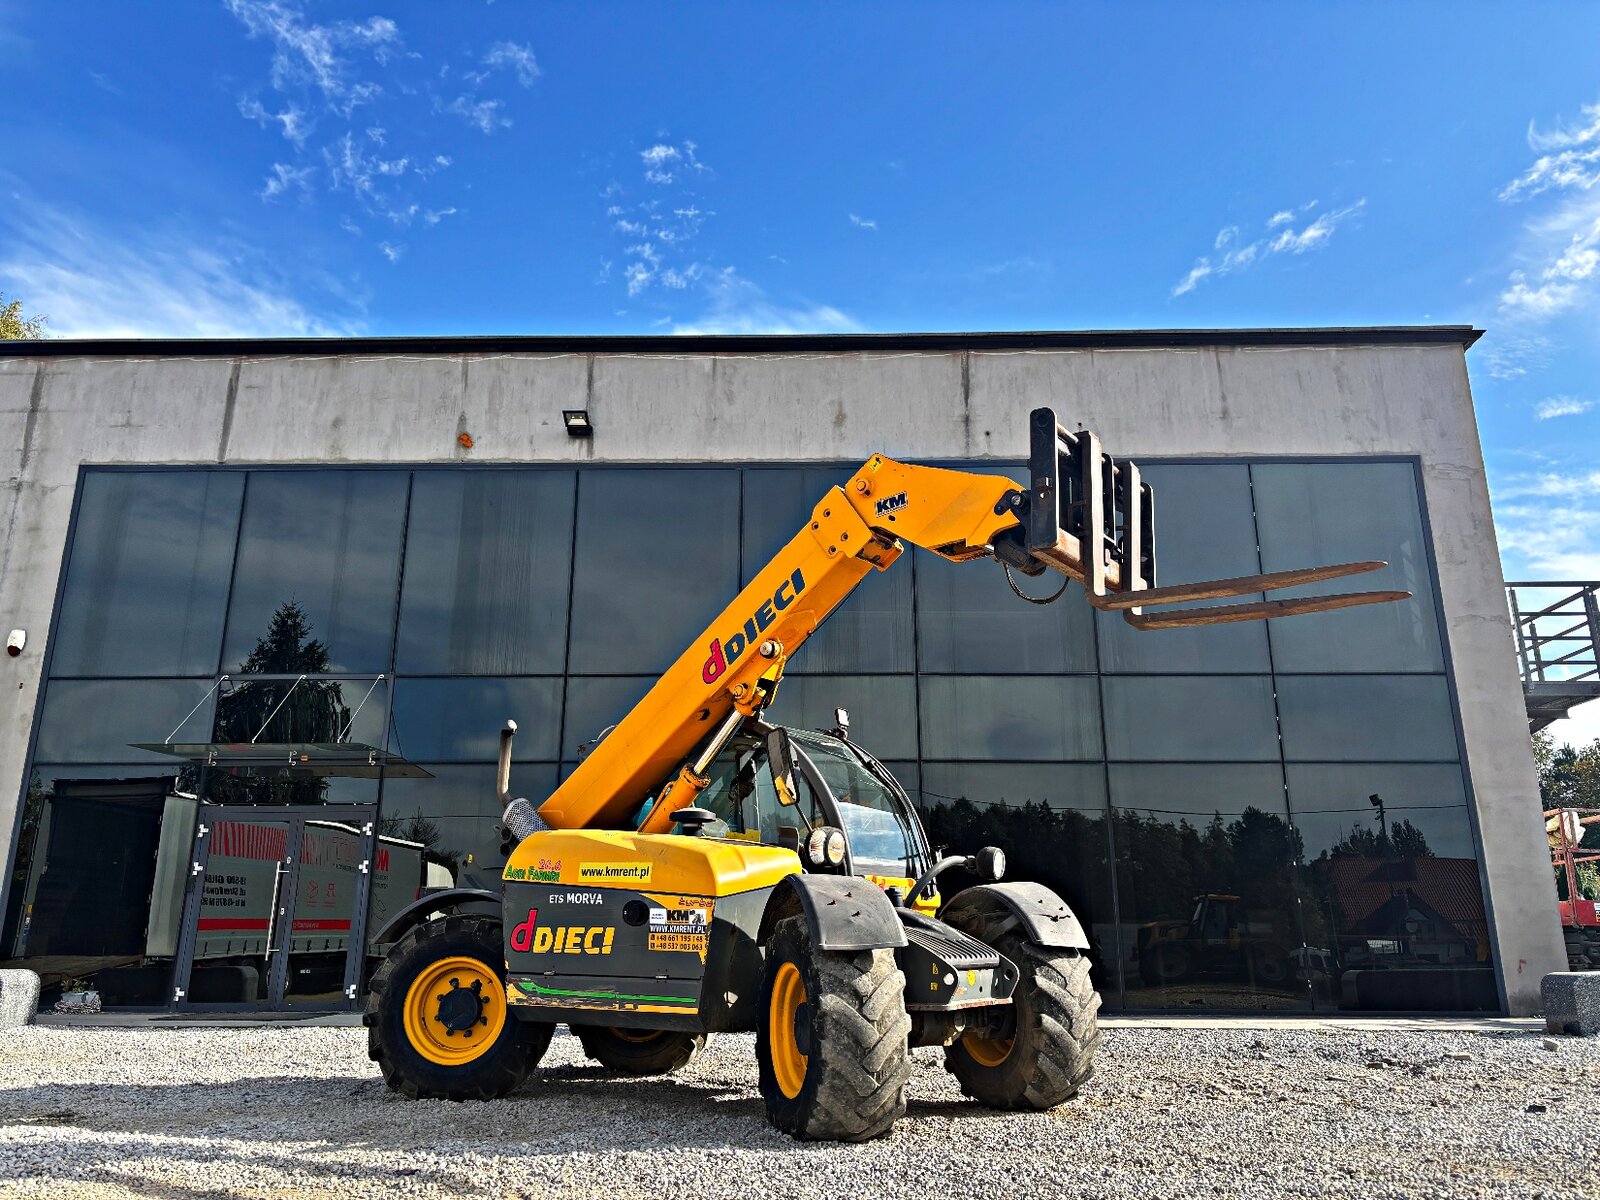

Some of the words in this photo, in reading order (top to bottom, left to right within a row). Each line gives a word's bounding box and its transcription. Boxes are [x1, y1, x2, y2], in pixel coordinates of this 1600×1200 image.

[876, 492, 907, 515] KM
[581, 865, 650, 880] www.kmrent.pl
[549, 894, 564, 904] ETS
[566, 893, 603, 905] MORVA
[666, 909, 689, 921] KM
[650, 925, 706, 934] WWW.KMRENT.PL
[668, 934, 679, 942] 661
